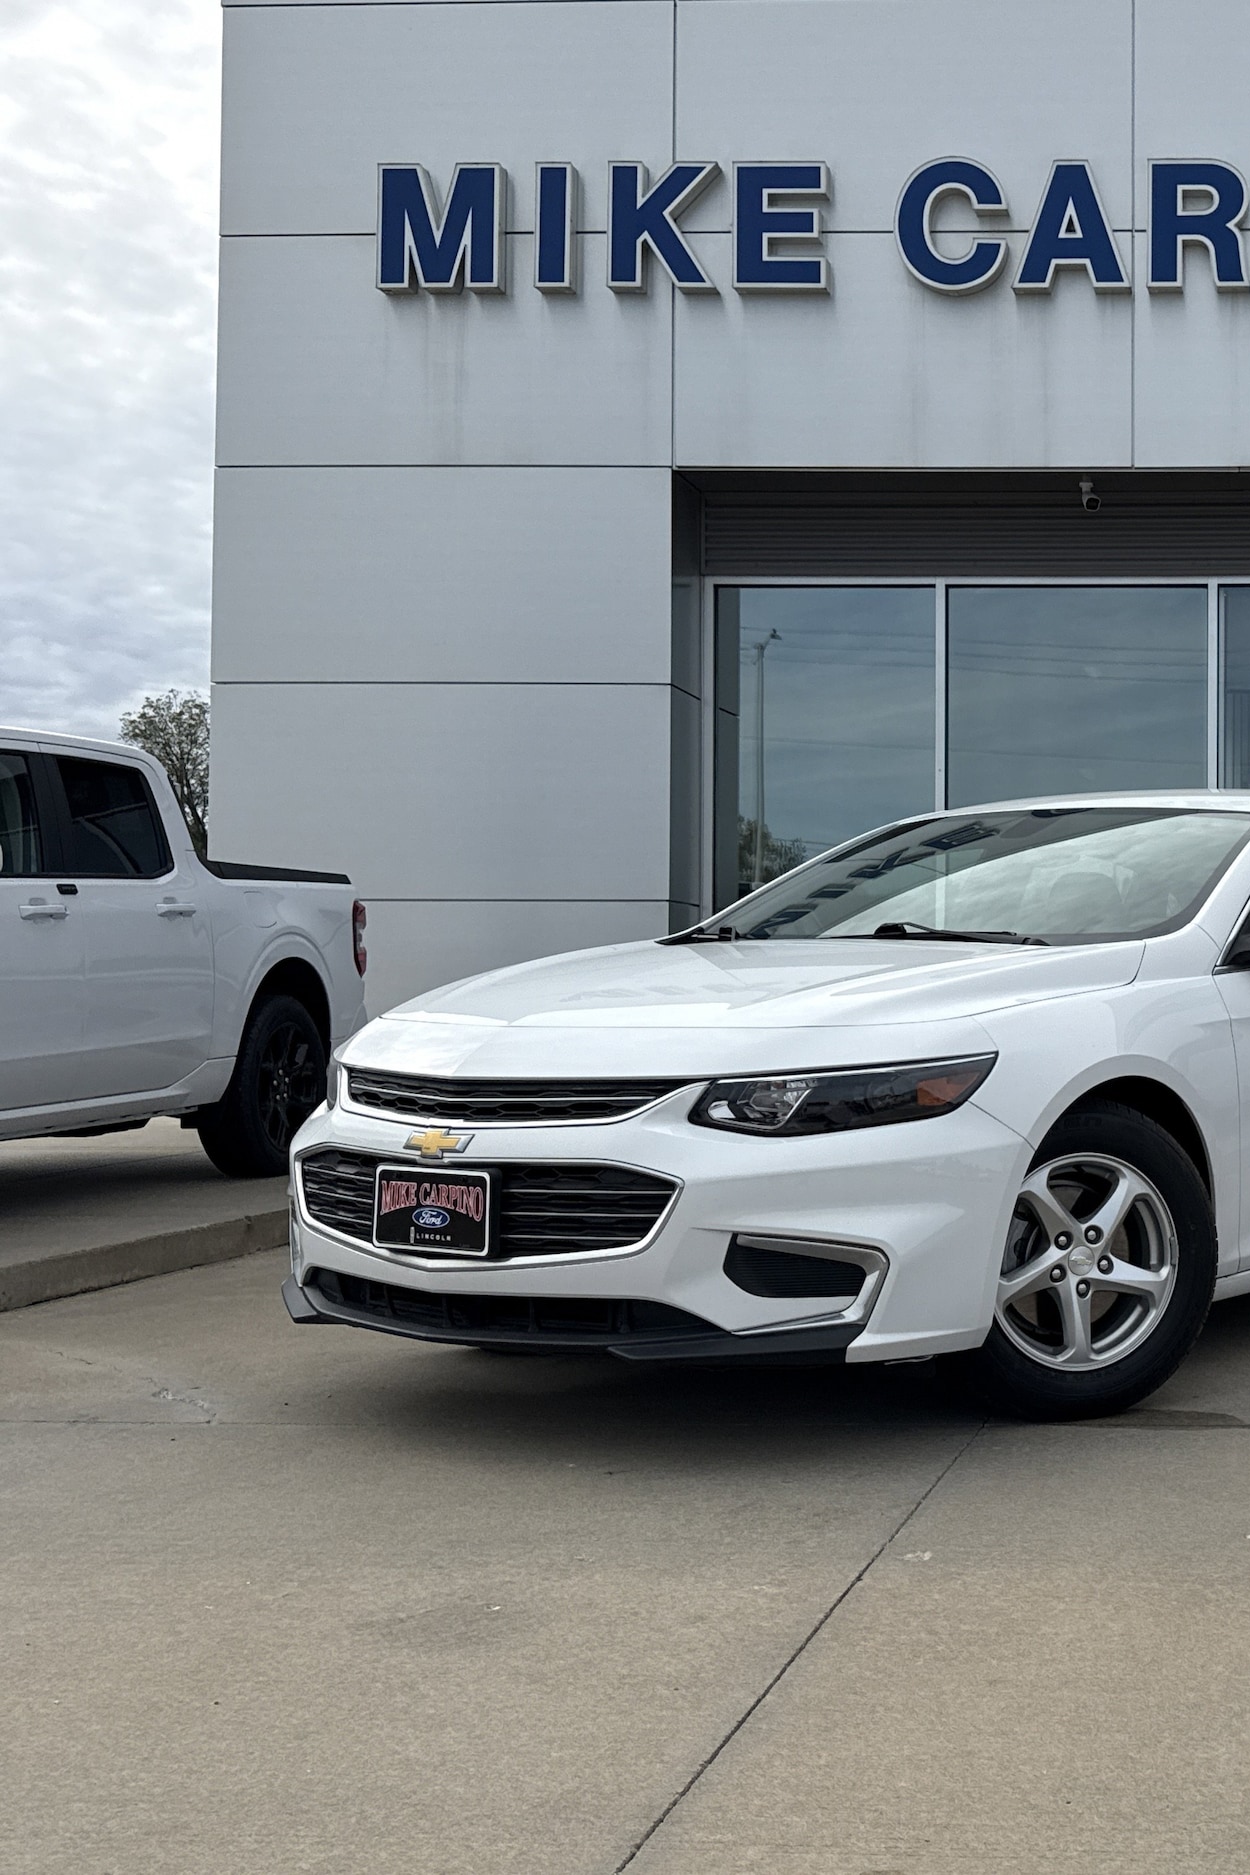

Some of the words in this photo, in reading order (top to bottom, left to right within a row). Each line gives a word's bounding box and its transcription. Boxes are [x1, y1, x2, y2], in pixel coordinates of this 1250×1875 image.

[376, 160, 831, 295] MIKE
[380, 1180, 417, 1216] MIKE
[420, 1183, 484, 1222] CARPINO
[419, 1210, 442, 1225] Ford
[416, 1233, 452, 1242] LINCOLN
